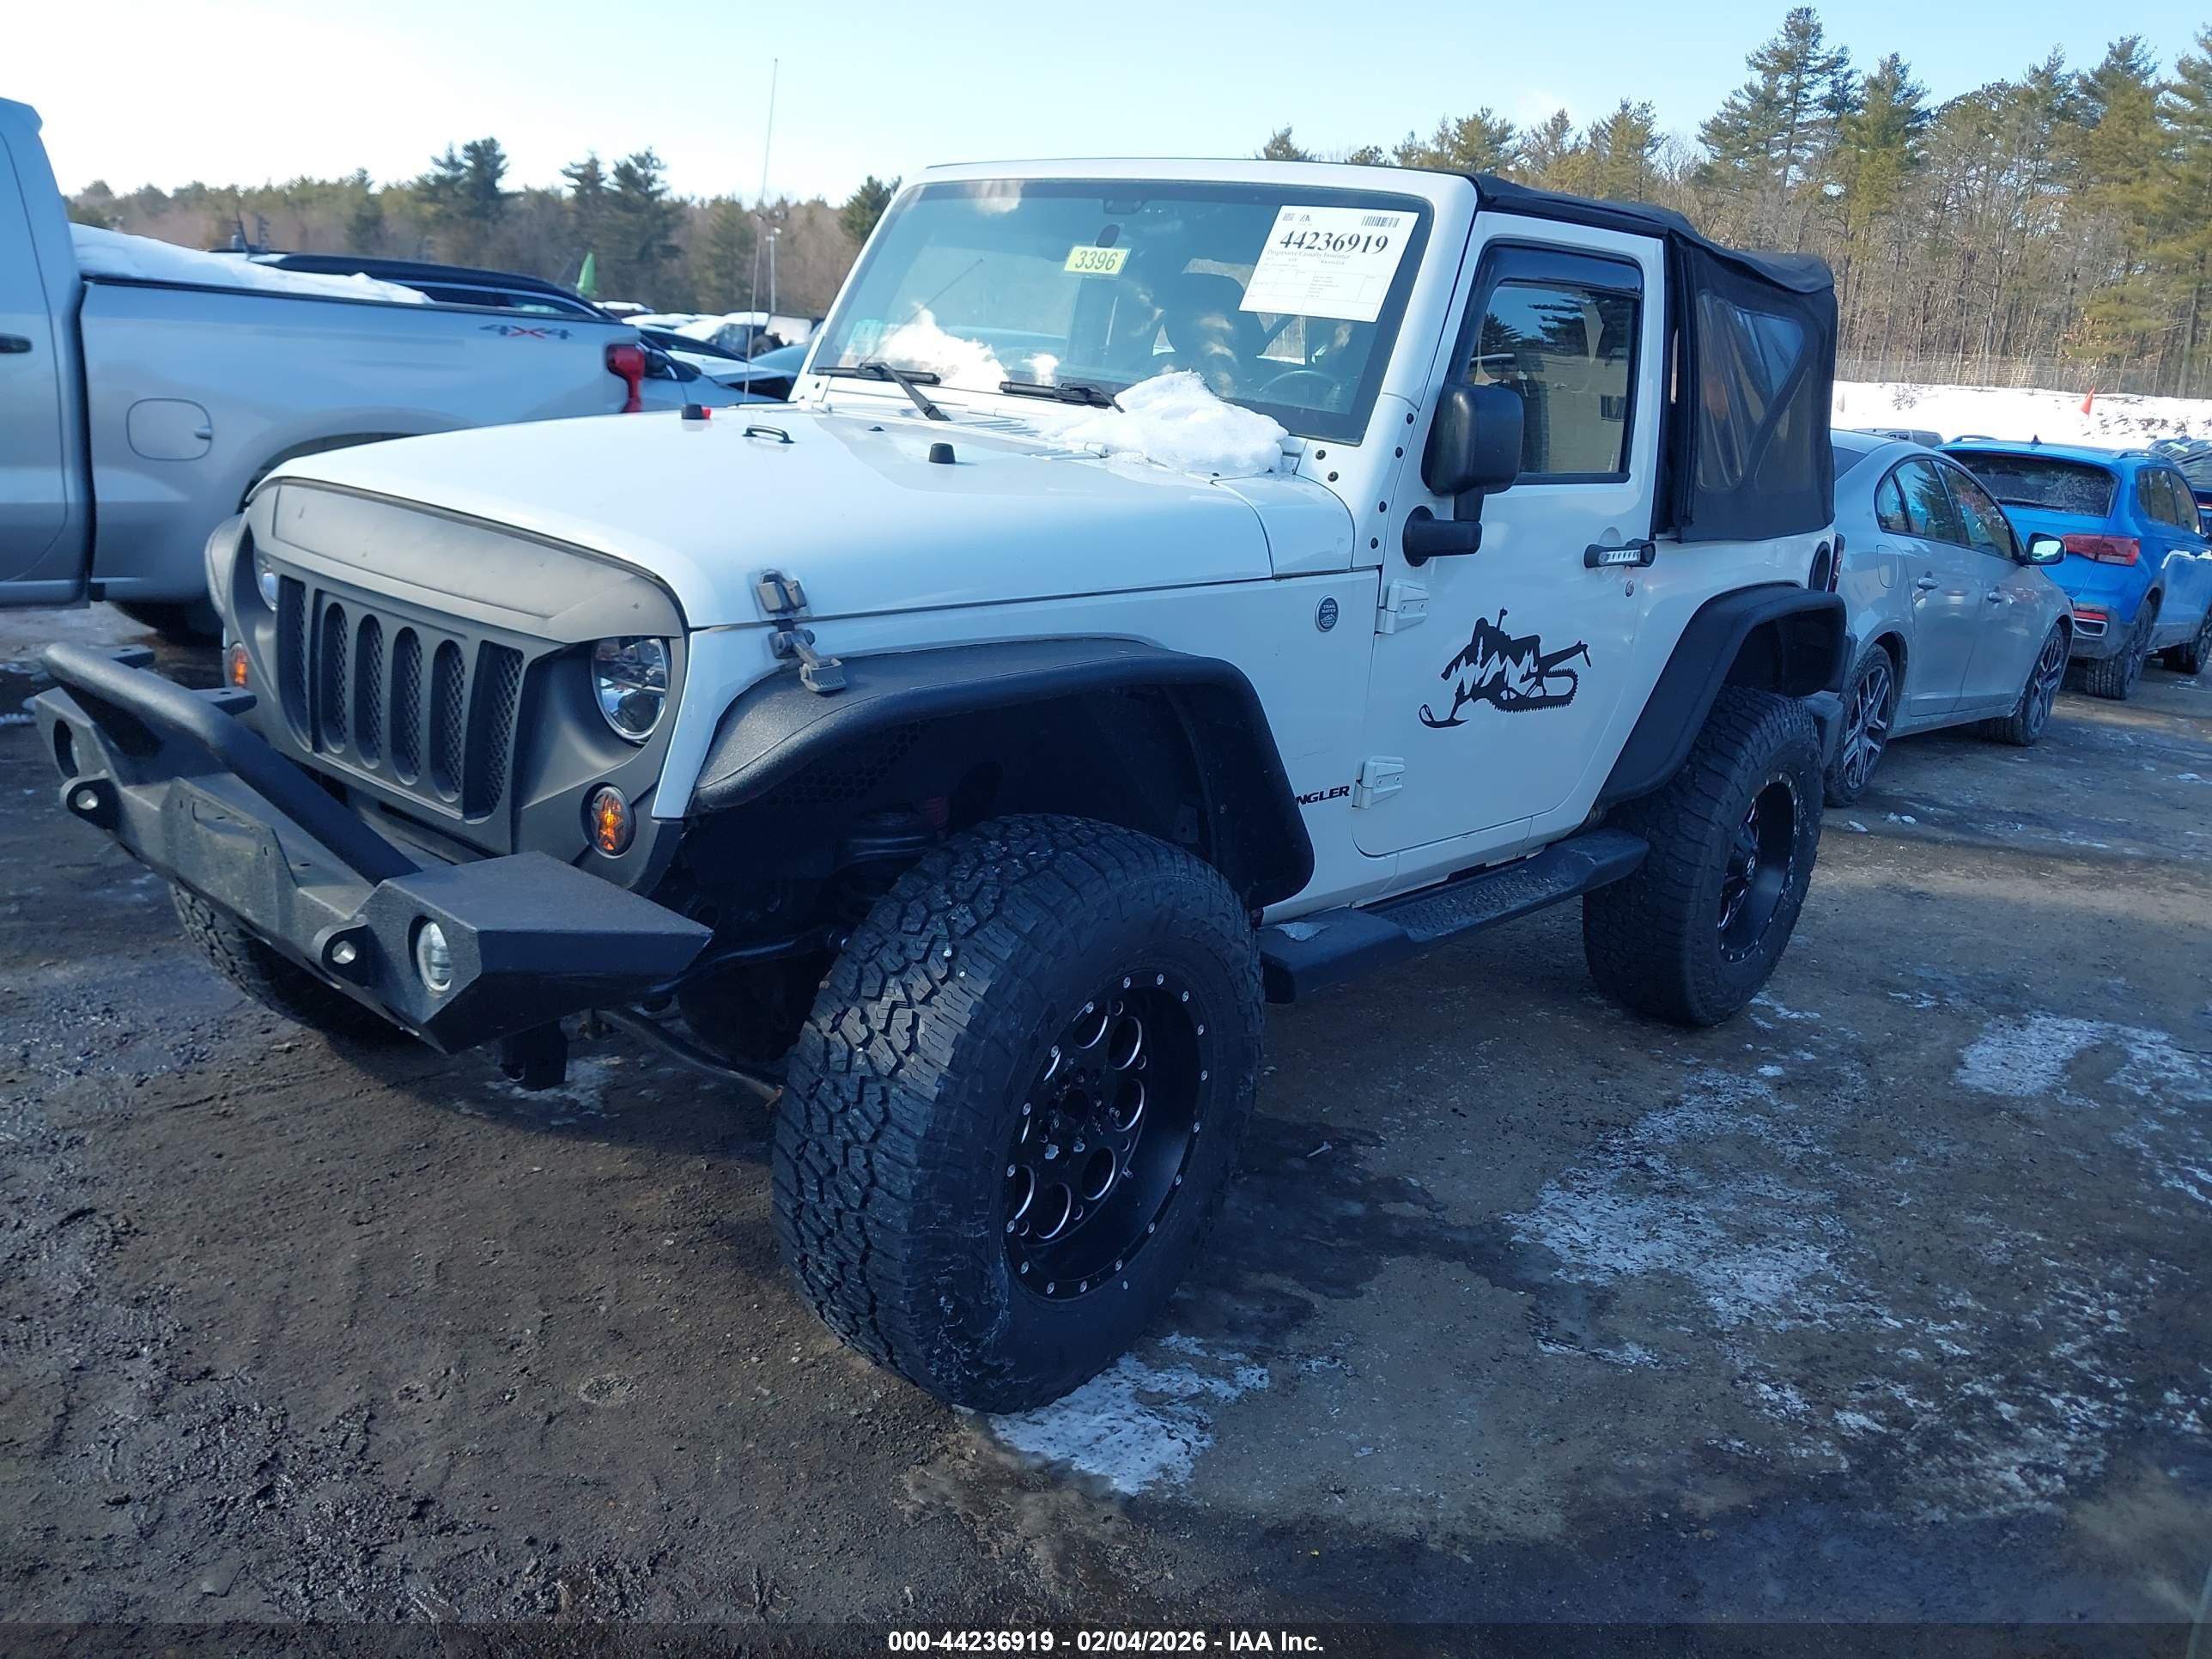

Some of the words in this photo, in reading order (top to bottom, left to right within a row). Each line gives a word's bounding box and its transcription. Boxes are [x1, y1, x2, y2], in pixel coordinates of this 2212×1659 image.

[1279, 230, 1389, 255] 44236919
[1074, 250, 1118, 270] 3396
[1296, 785, 1350, 805] NGLER
